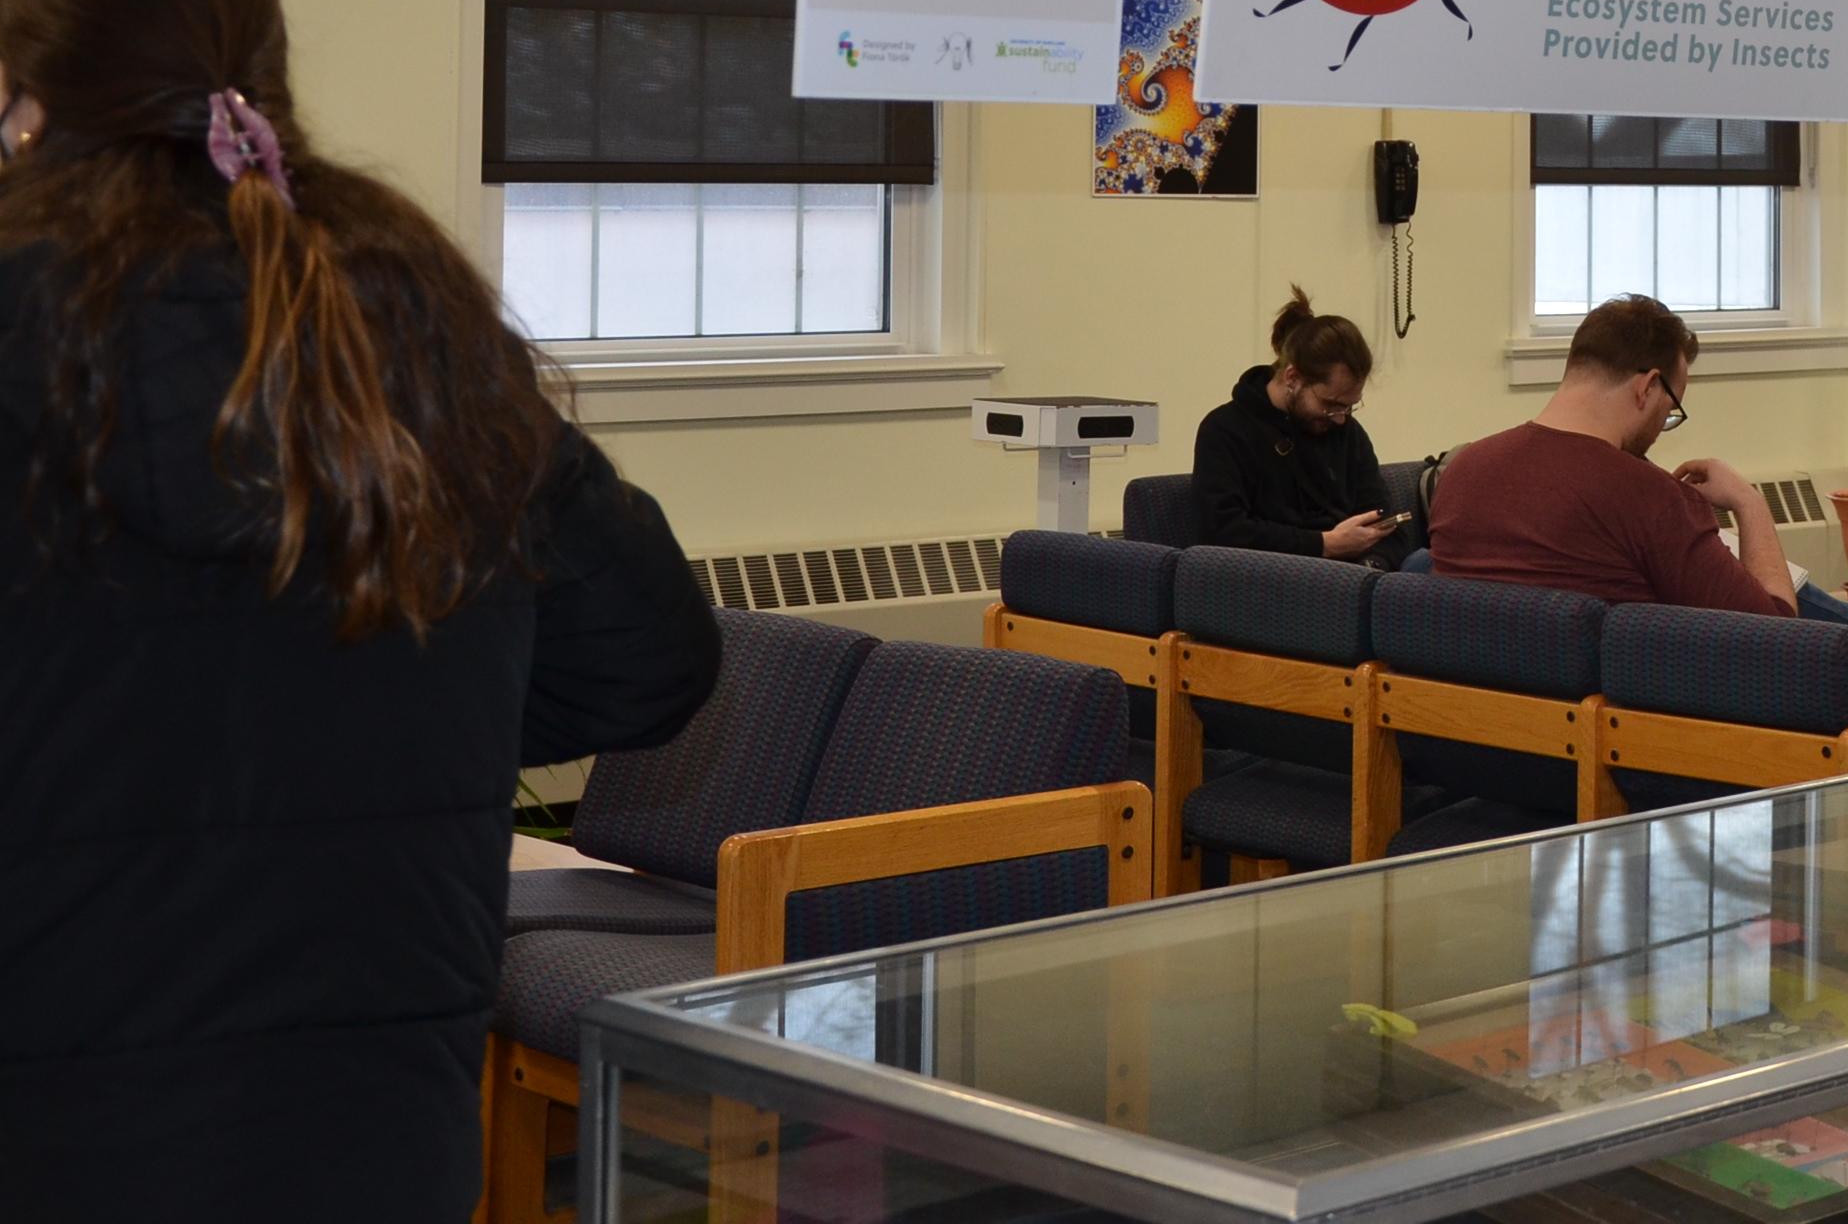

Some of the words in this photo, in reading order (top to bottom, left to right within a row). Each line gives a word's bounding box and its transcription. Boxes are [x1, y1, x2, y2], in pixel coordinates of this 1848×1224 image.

[1716, 0, 1834, 32] Services
[1543, 28, 1678, 62] Provided
[1688, 34, 1722, 73] by
[1732, 38, 1830, 69] Insects
